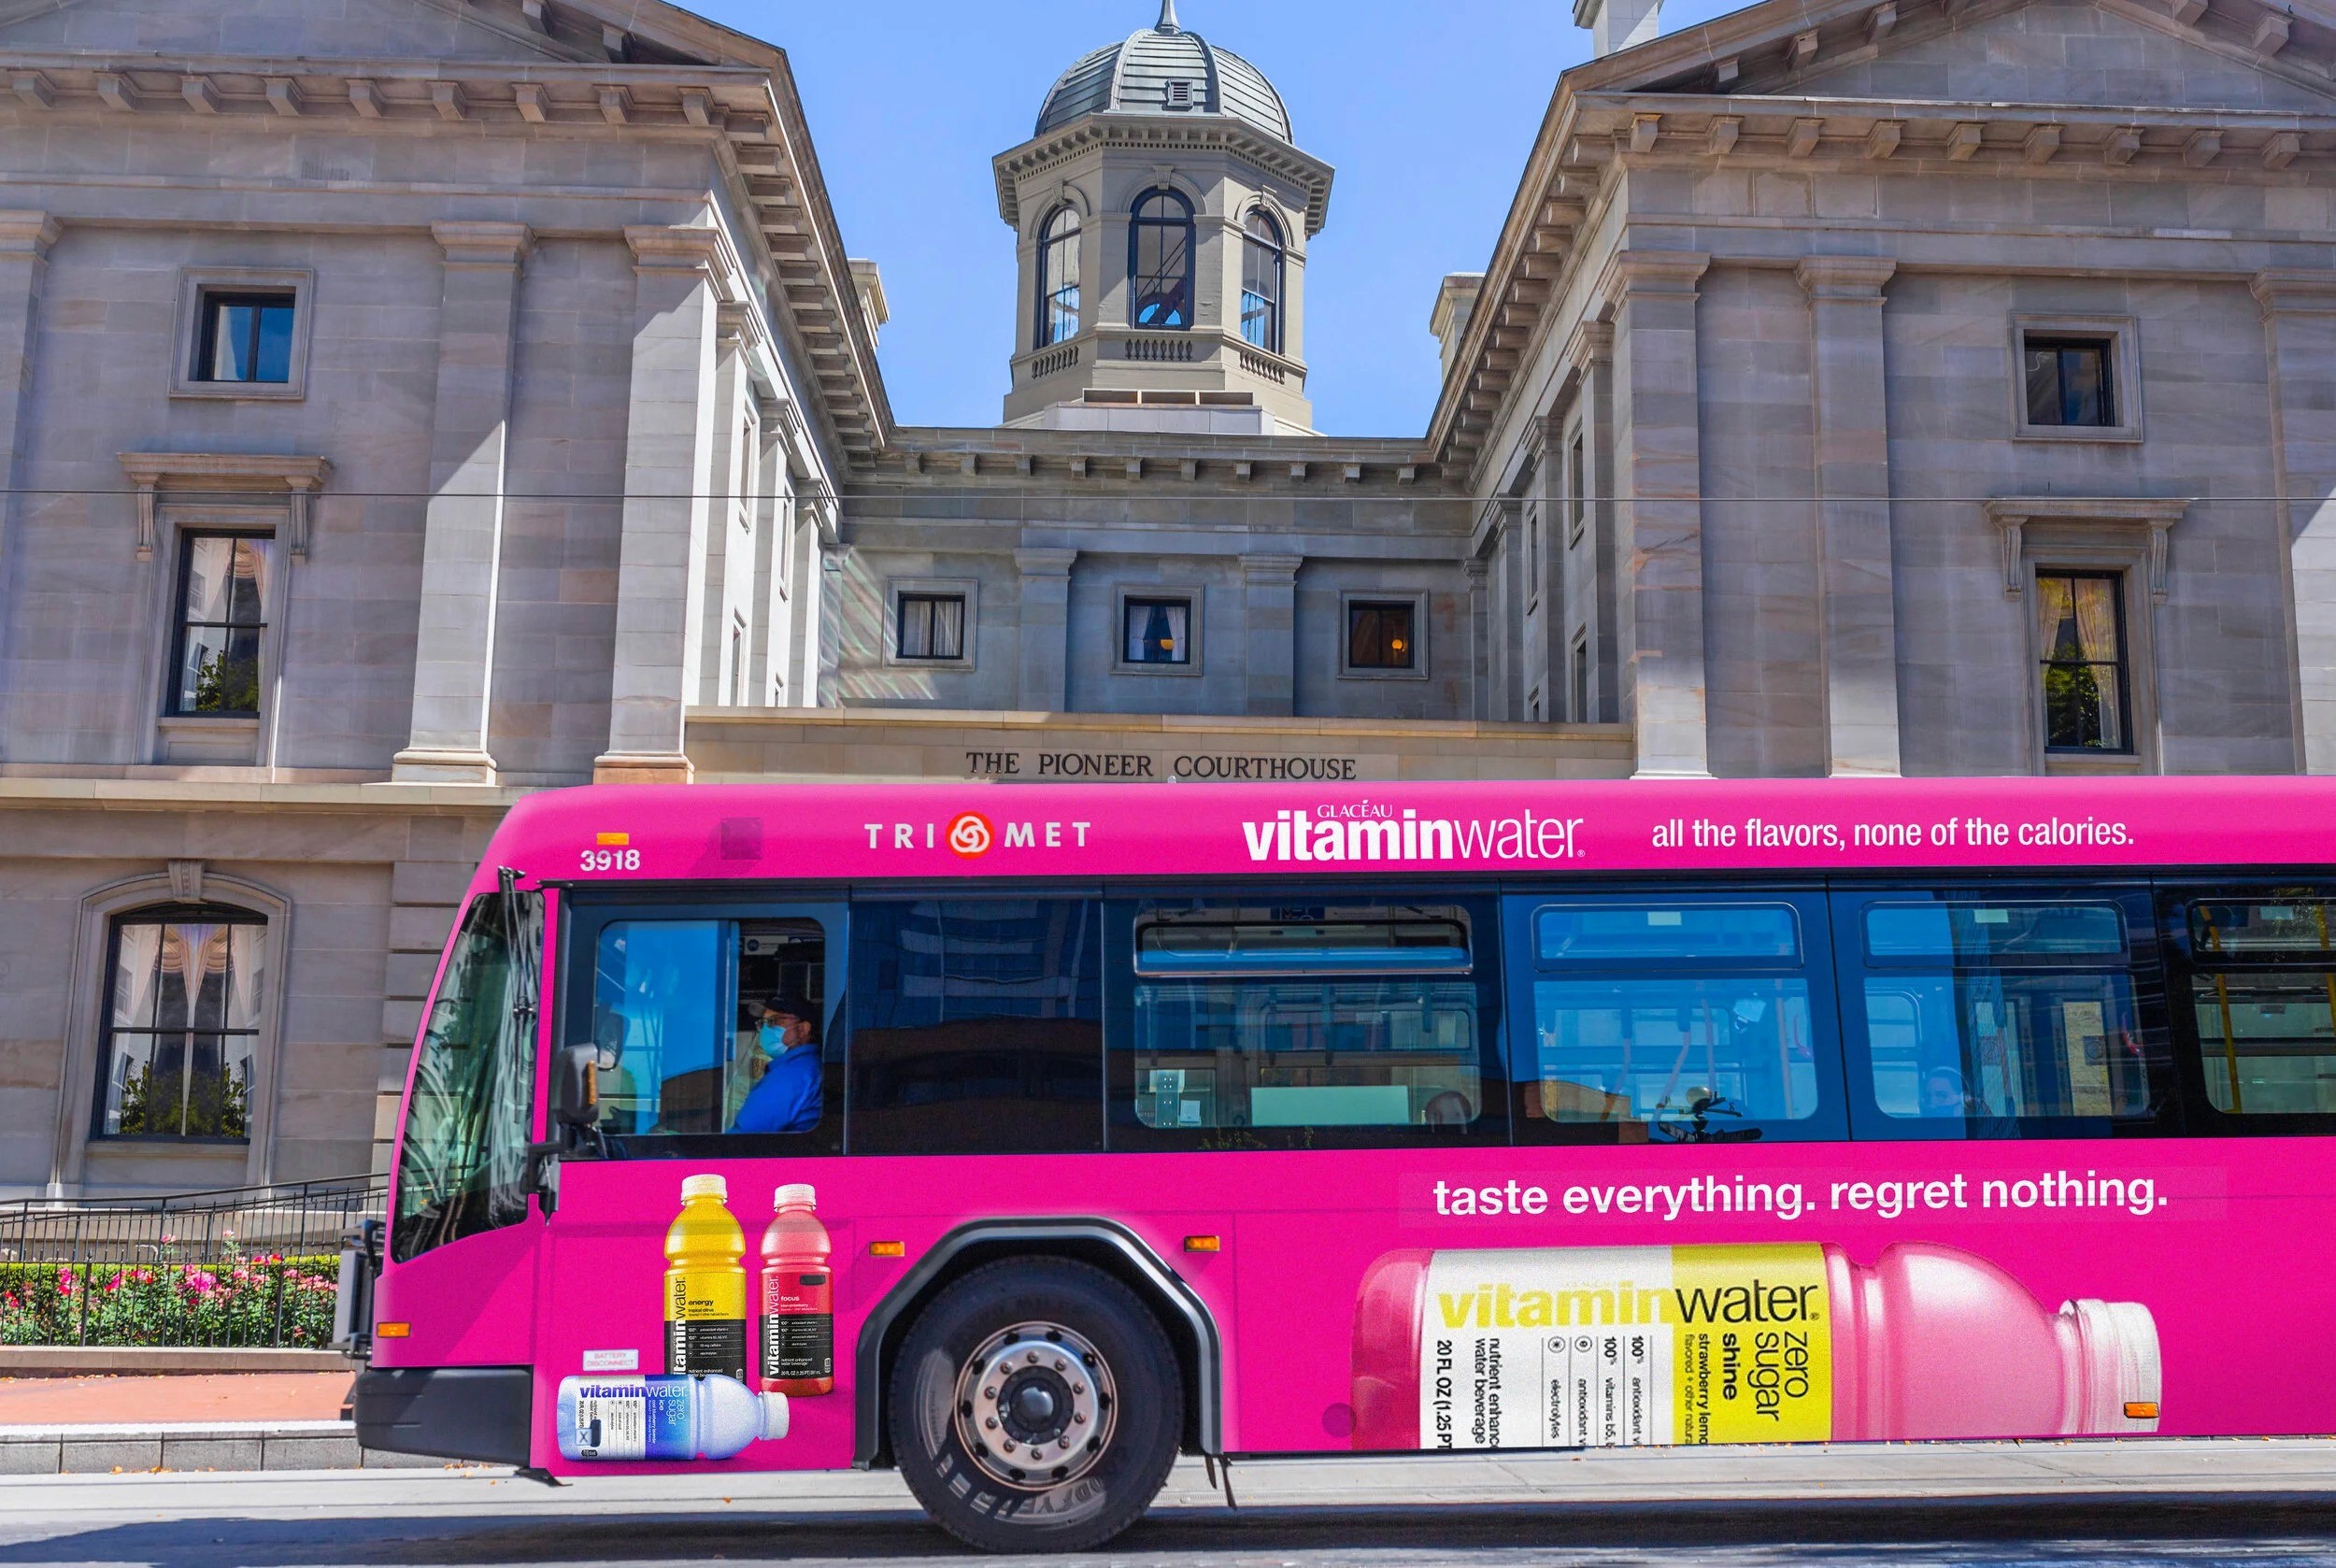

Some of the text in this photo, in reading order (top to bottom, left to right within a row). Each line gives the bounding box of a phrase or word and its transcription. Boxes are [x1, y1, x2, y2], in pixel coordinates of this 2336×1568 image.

[965, 752, 1357, 780] THE PIONEER COURTHOUSE
[1317, 799, 1393, 819] GLACÉAU
[864, 821, 1091, 849] TRI MET
[1652, 816, 2134, 851] all the flavors, none of the calories.
[579, 849, 641, 872] 3918
[1433, 1170, 2168, 1221] taste everything. regret nothing.
[673, 1276, 687, 1375] itaminwater
[1436, 1340, 1452, 1356] 20
[1488, 1338, 1502, 1391] nutrient
[1604, 1336, 1617, 1365] 100%
[1631, 1335, 1645, 1365] 100%
[1685, 1334, 1695, 1374] flavored
[1784, 1332, 1809, 1398] zero
[1437, 1359, 1452, 1375] FL
[1697, 1333, 1711, 1409] strawberry
[1722, 1333, 1741, 1401] shine
[1747, 1332, 1780, 1421] sugar
[1436, 1377, 1452, 1398] OZ
[1472, 1339, 1486, 1444] water beverage
[1605, 1377, 1616, 1421] vitamins
[1631, 1376, 1642, 1434] antioxidant
[1685, 1386, 1694, 1411] other
[666, 1400, 677, 1426] sugar
[677, 1400, 685, 1419] zero
[1432, 1400, 1452, 1432] (1.25
[1550, 1379, 1560, 1439] electrolytes
[1577, 1378, 1587, 1439] antioxidant
